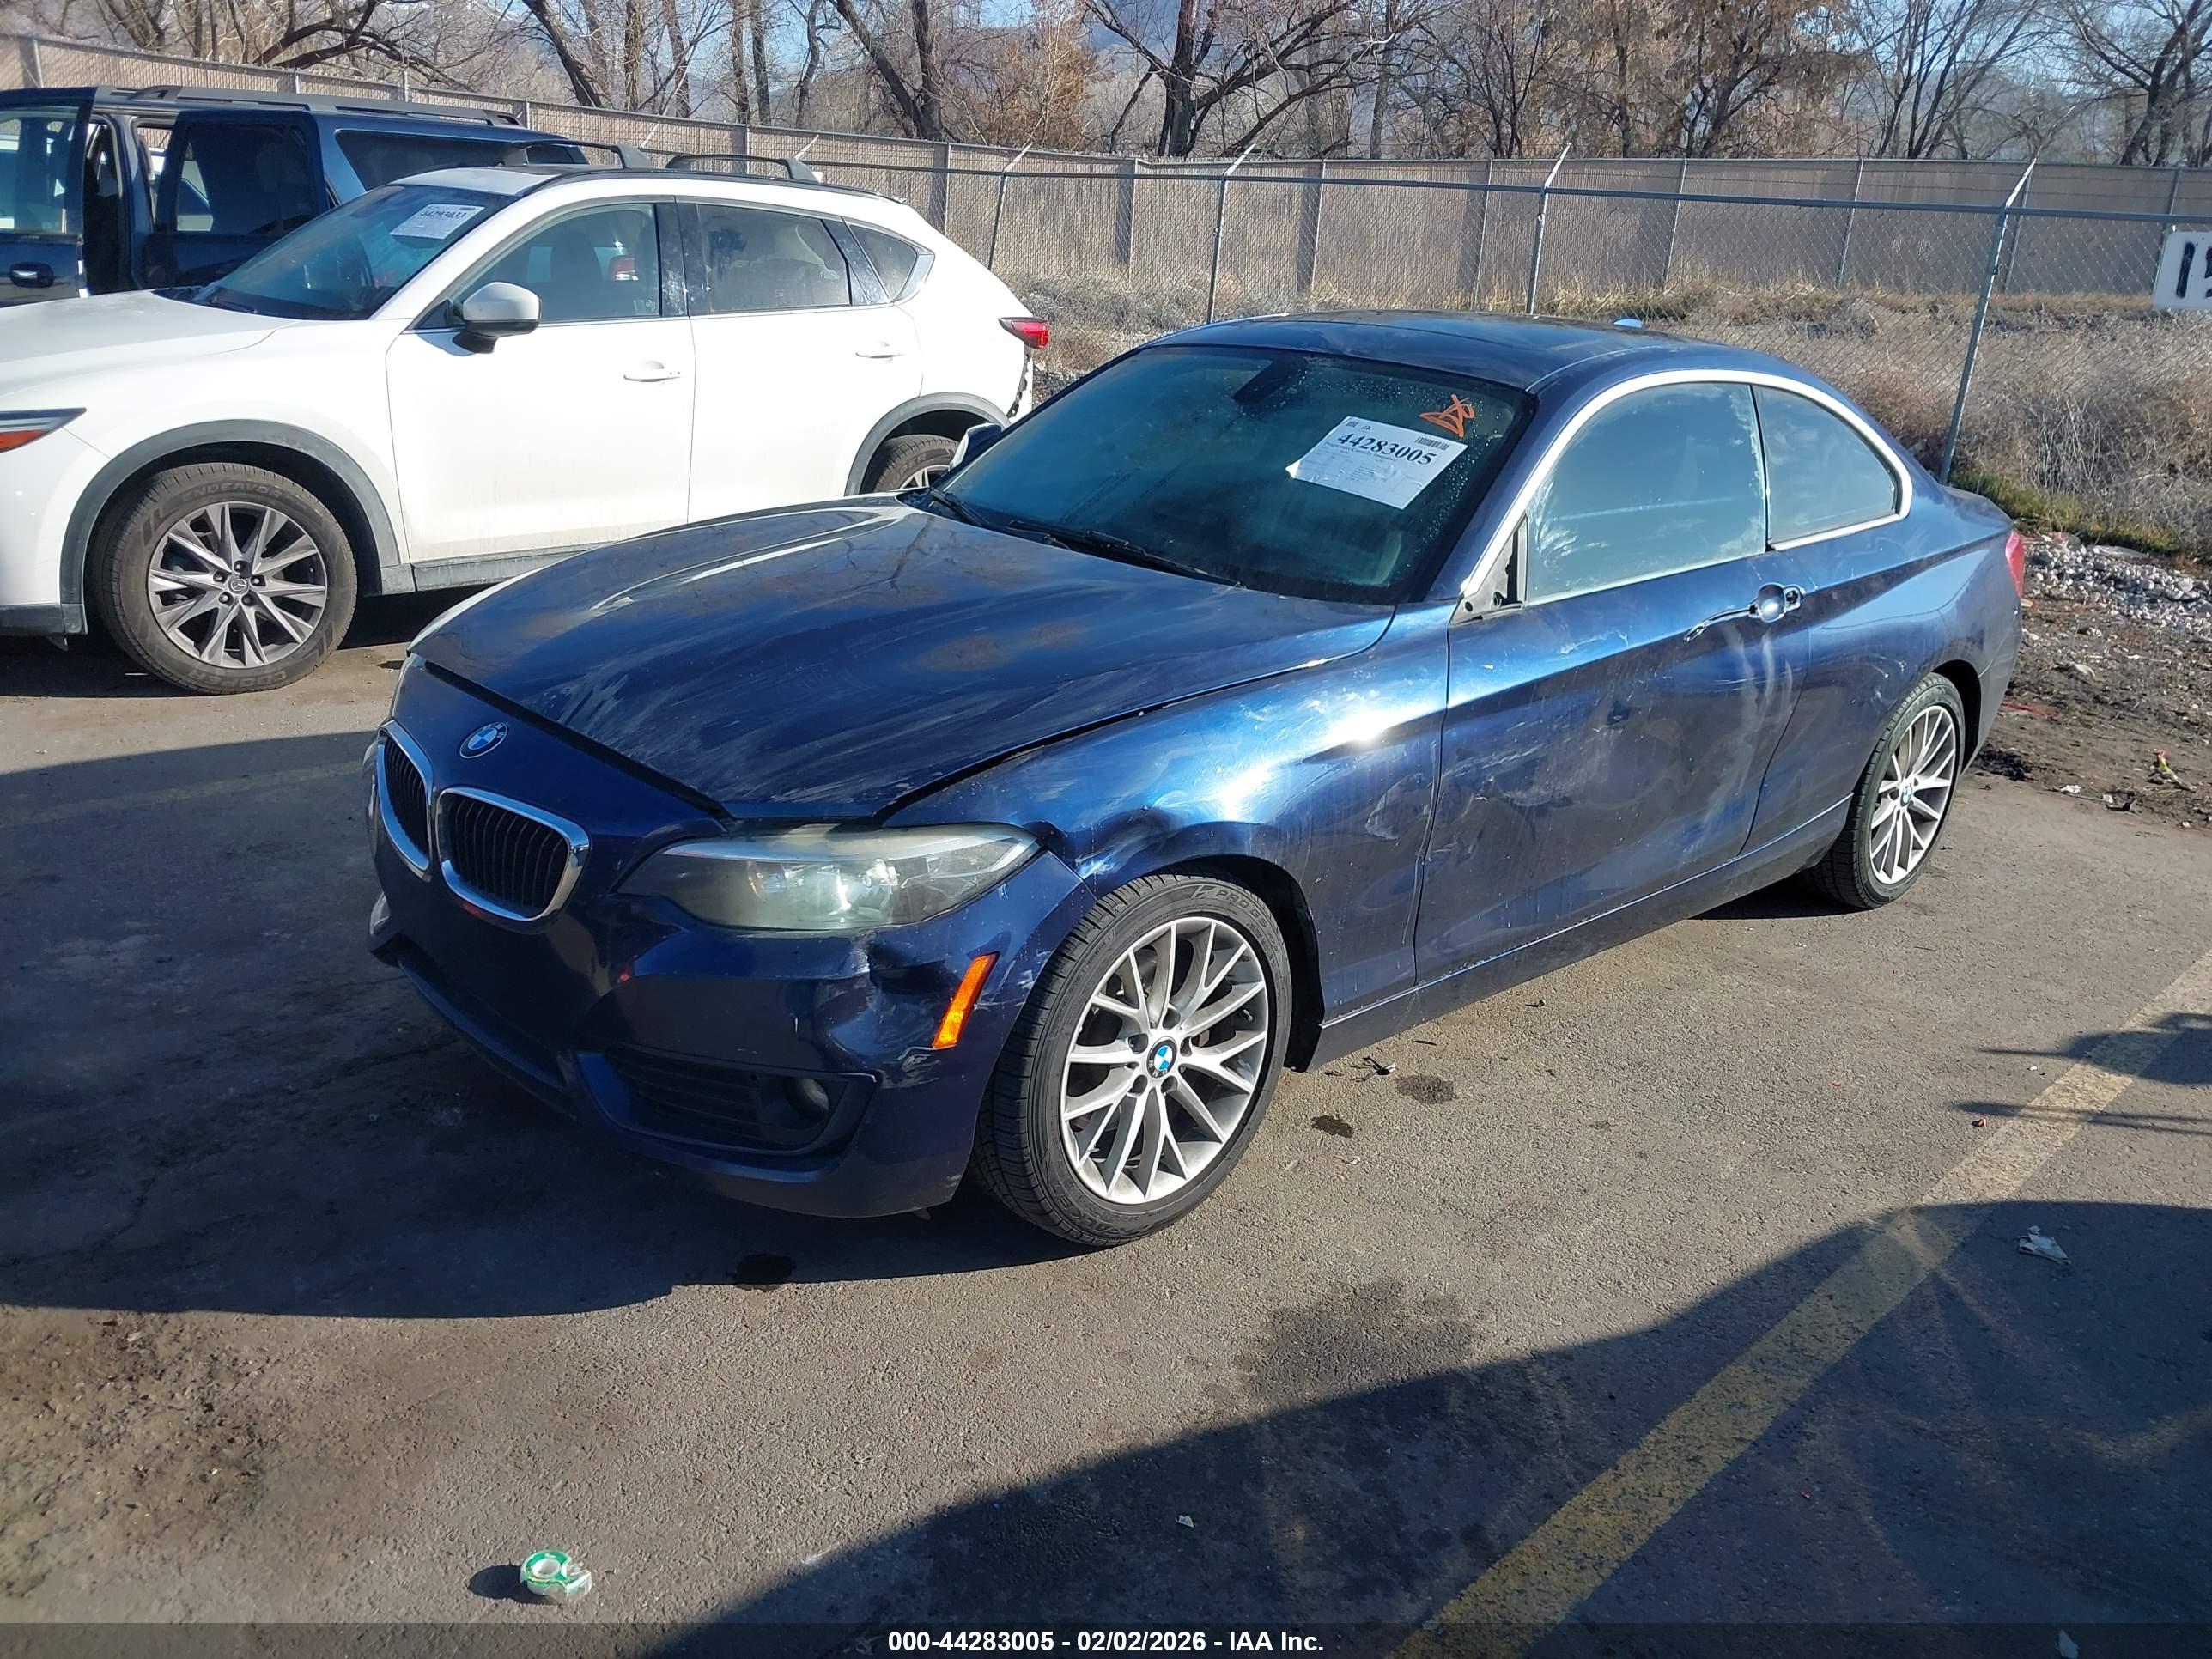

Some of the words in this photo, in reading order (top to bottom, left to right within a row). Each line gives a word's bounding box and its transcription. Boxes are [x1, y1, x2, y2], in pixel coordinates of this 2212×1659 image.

[2176, 241, 2212, 298] 1
[1338, 433, 1437, 465] 44283005
[189, 670, 286, 686] COOPER
